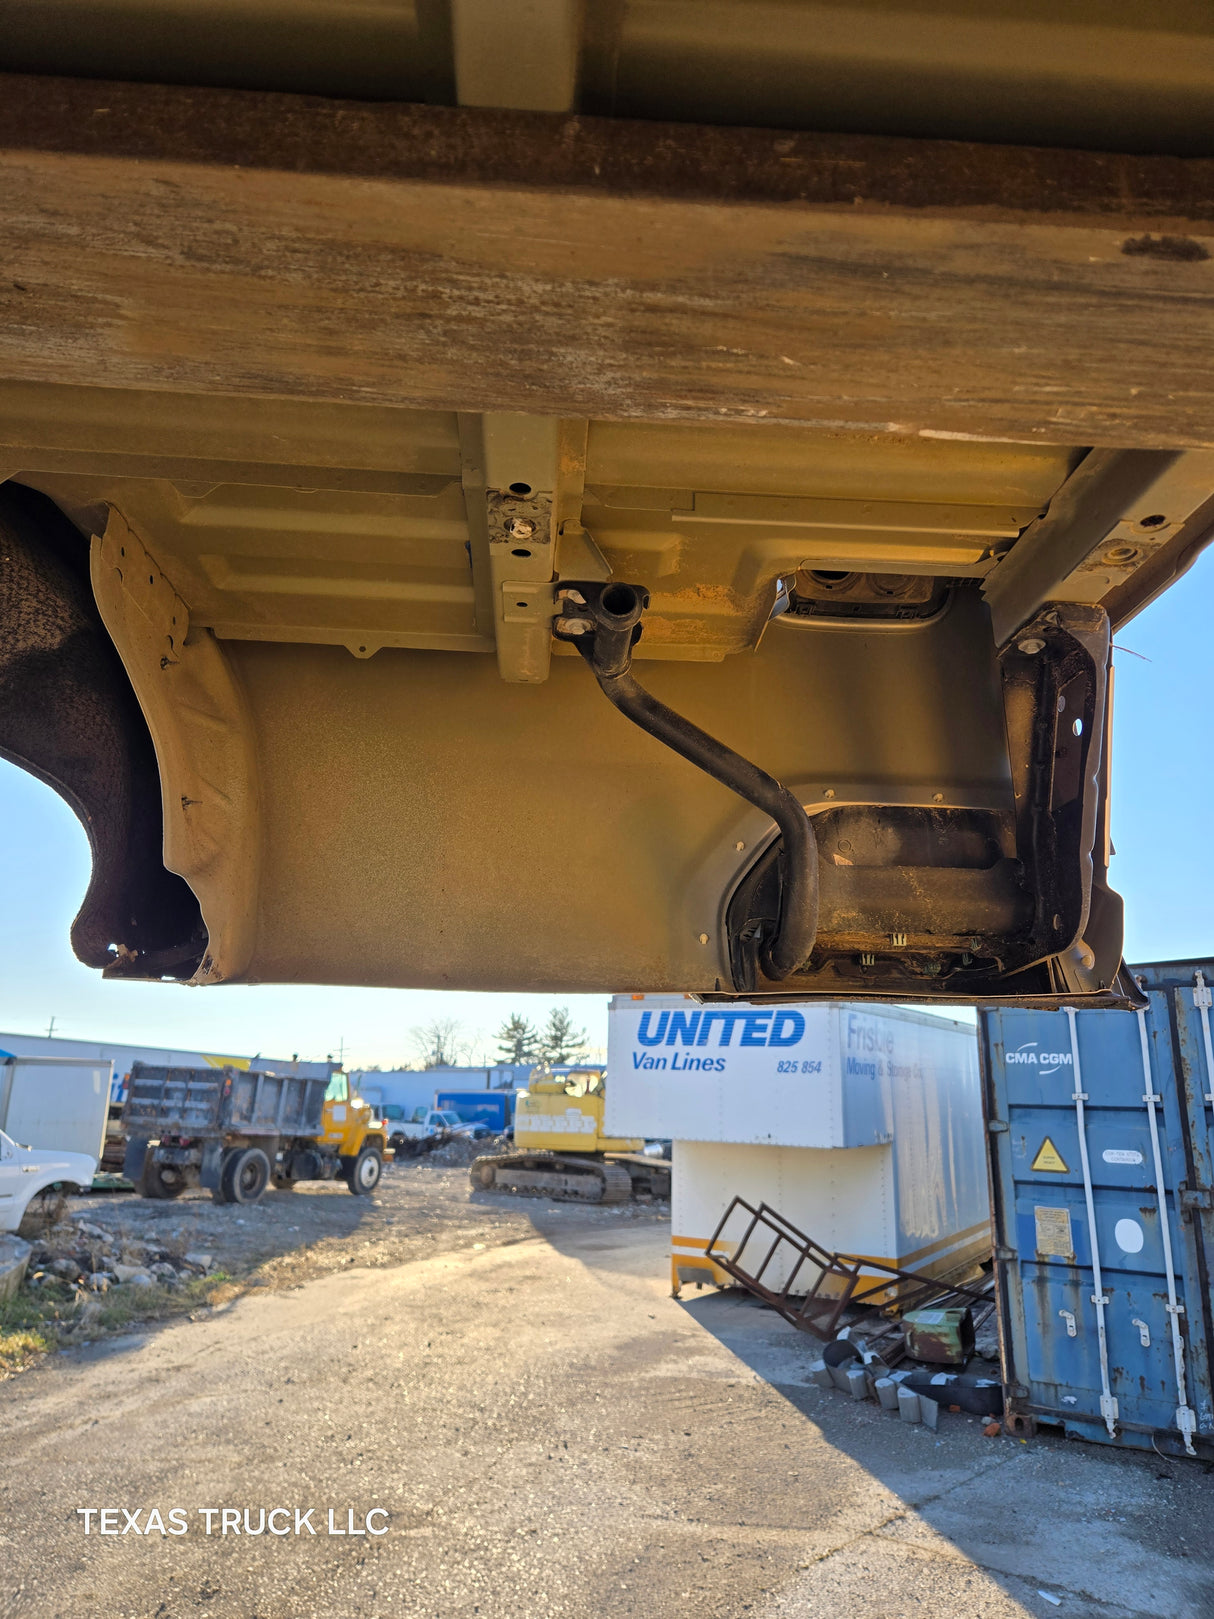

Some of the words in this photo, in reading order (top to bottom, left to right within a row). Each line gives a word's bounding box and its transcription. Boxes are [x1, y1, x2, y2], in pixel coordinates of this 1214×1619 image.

[637, 1010, 805, 1047] UNITED
[632, 1051, 667, 1071] Van
[671, 1051, 726, 1072] Lines
[777, 1060, 798, 1073] 825
[801, 1061, 822, 1074] 854
[846, 1056, 876, 1080] Moving
[1005, 1052, 1038, 1064] CMA
[1040, 1053, 1072, 1065] CGM
